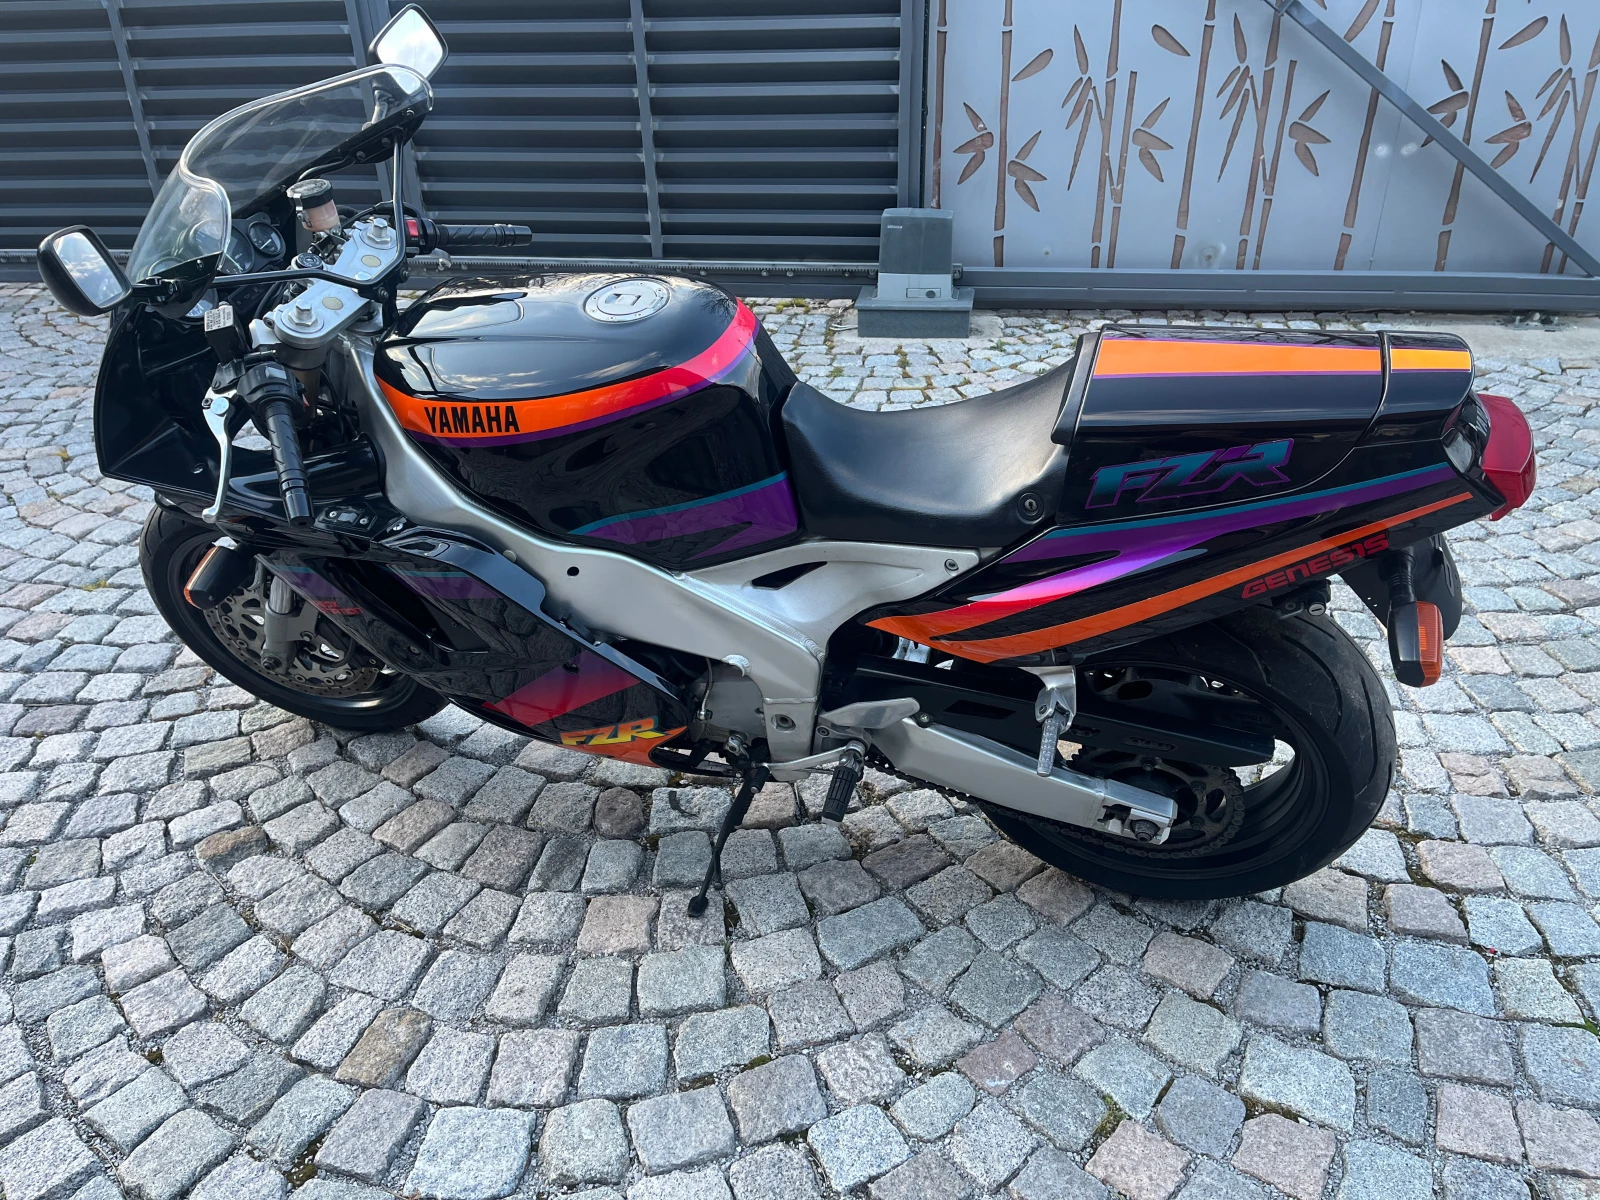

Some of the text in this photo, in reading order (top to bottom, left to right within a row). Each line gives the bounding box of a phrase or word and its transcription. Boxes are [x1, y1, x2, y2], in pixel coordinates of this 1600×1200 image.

[423, 405, 520, 433] YAMAHA
[1085, 438, 1294, 509] FZR
[1241, 533, 1389, 599] GENESIS
[560, 716, 665, 746] FZR
